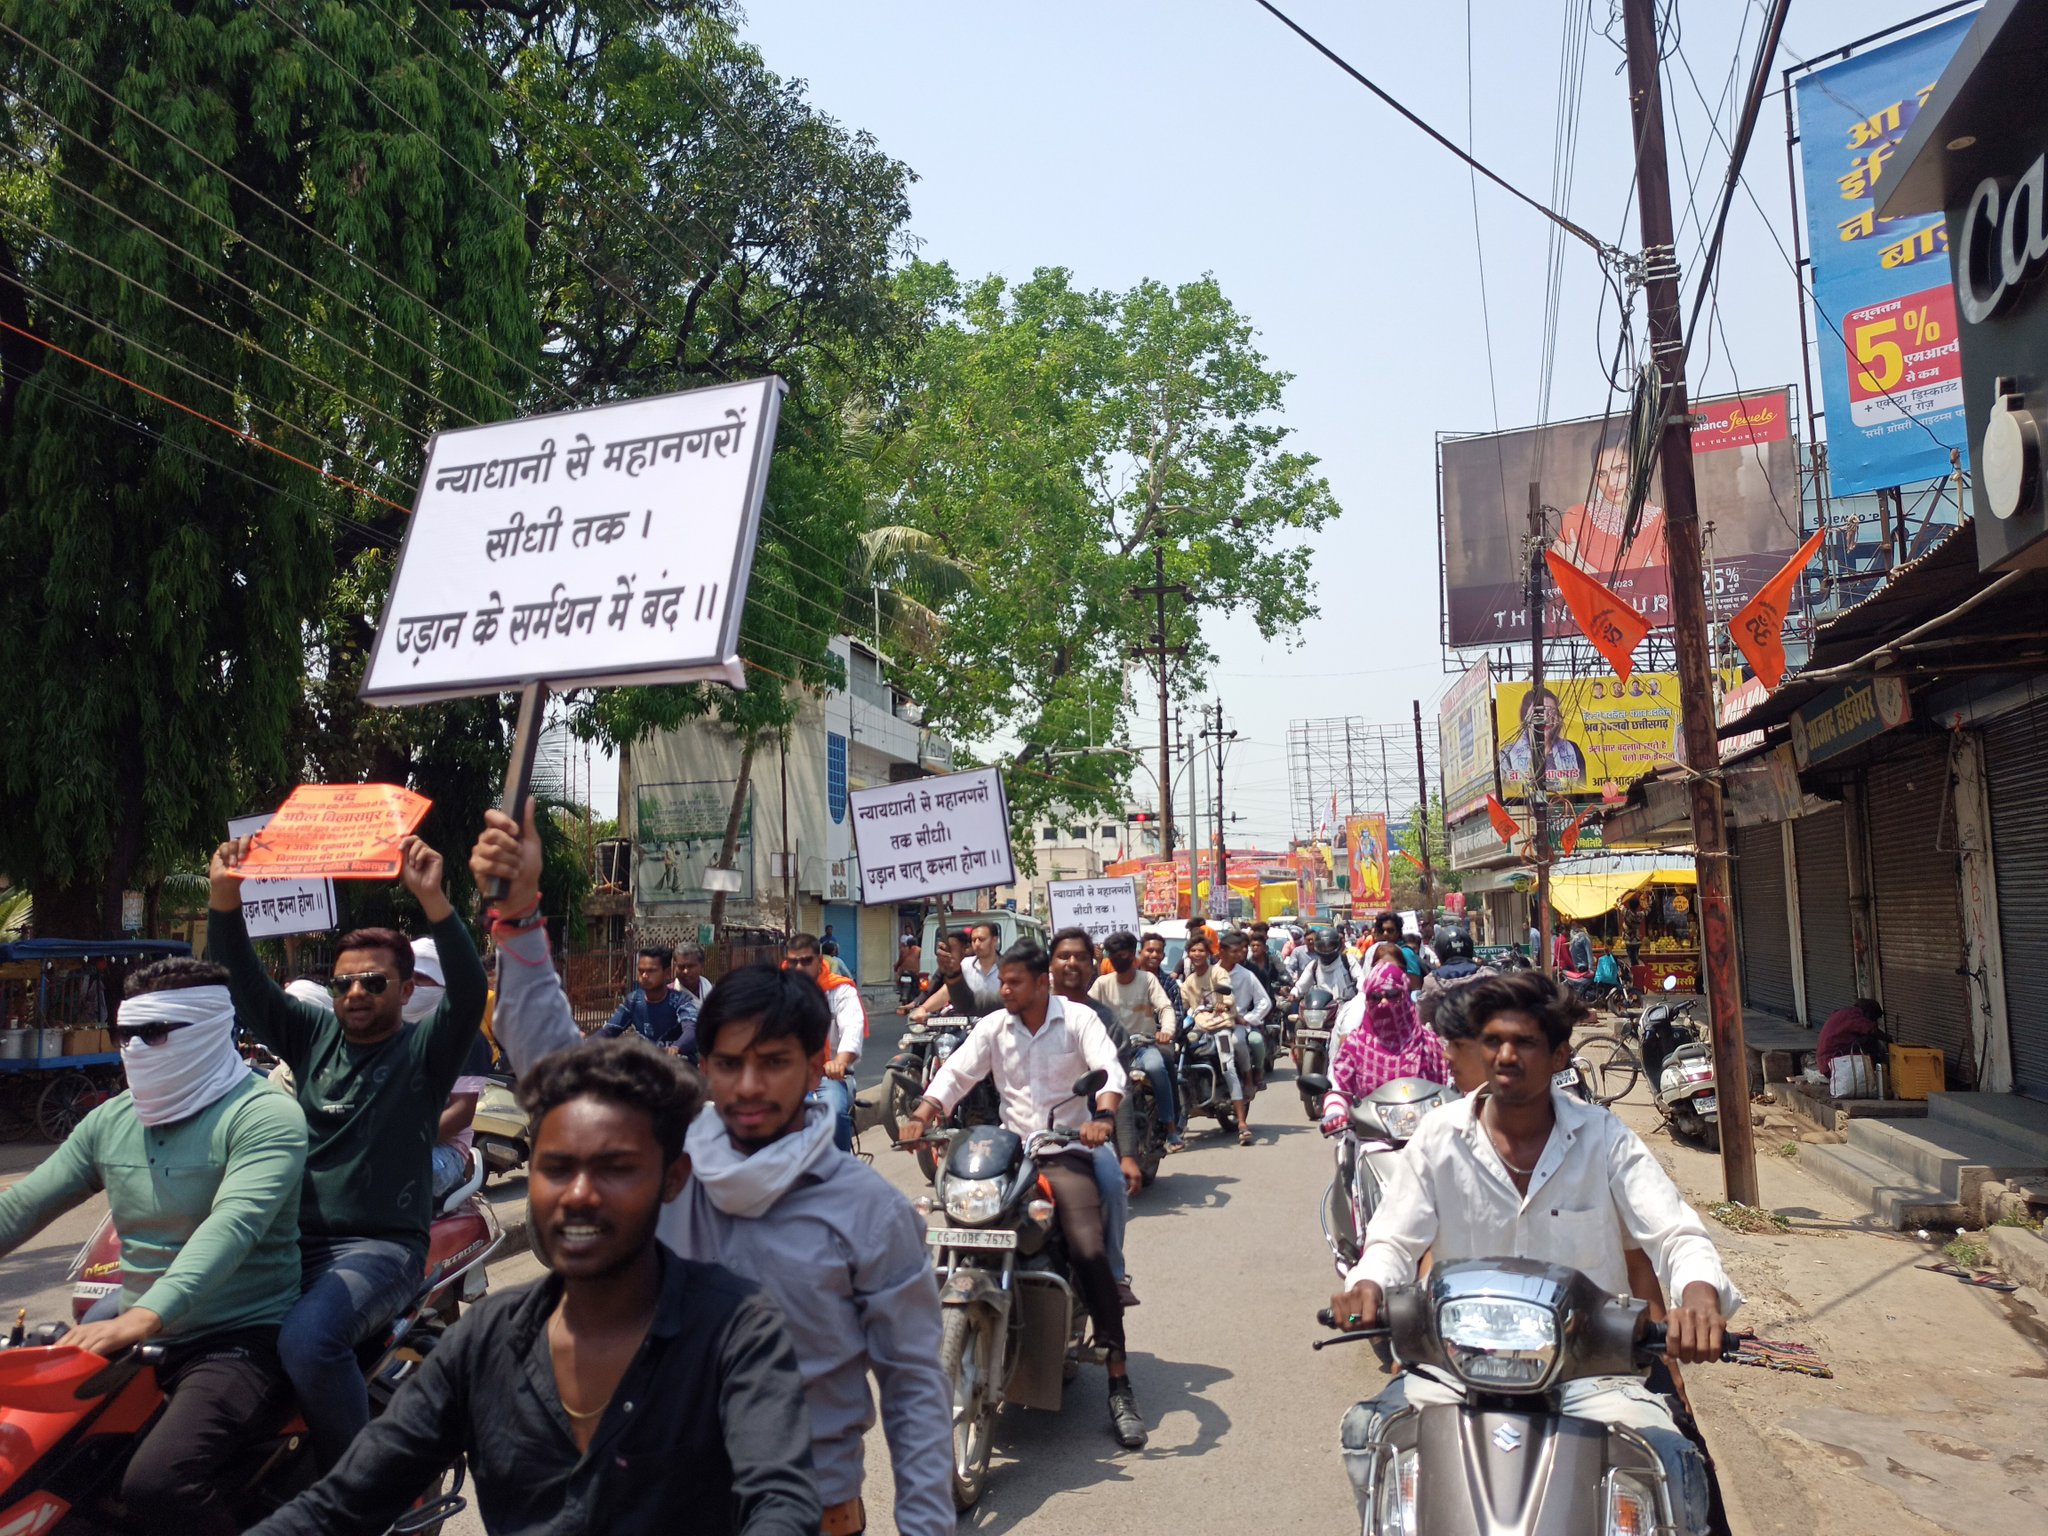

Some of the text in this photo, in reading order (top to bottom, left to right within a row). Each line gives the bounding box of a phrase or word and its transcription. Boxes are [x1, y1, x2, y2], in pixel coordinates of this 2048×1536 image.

[435, 407, 747, 493] न्याधानी से महानगरों
[486, 506, 562, 562] सीधी
[572, 511, 629, 548] तक
[396, 612, 467, 667] उड़ान
[471, 591, 503, 646] के
[608, 574, 636, 632] में
[641, 570, 685, 634] बंद
[858, 780, 989, 820] न्यायधानी से महानगरों
[890, 833, 912, 849] तक
[867, 865, 896, 889] उड़ान
[899, 861, 928, 883] चालू
[926, 855, 958, 875] करना
[960, 845, 987, 874] होगा
[261, 899, 279, 922] चालू
[277, 896, 297, 915] करना
[297, 886, 315, 917] होगा
[1072, 903, 1092, 915] सीधी
[1095, 905, 1109, 914] तक
[1087, 885, 1094, 897] से
[1097, 882, 1131, 897] महानगरों
